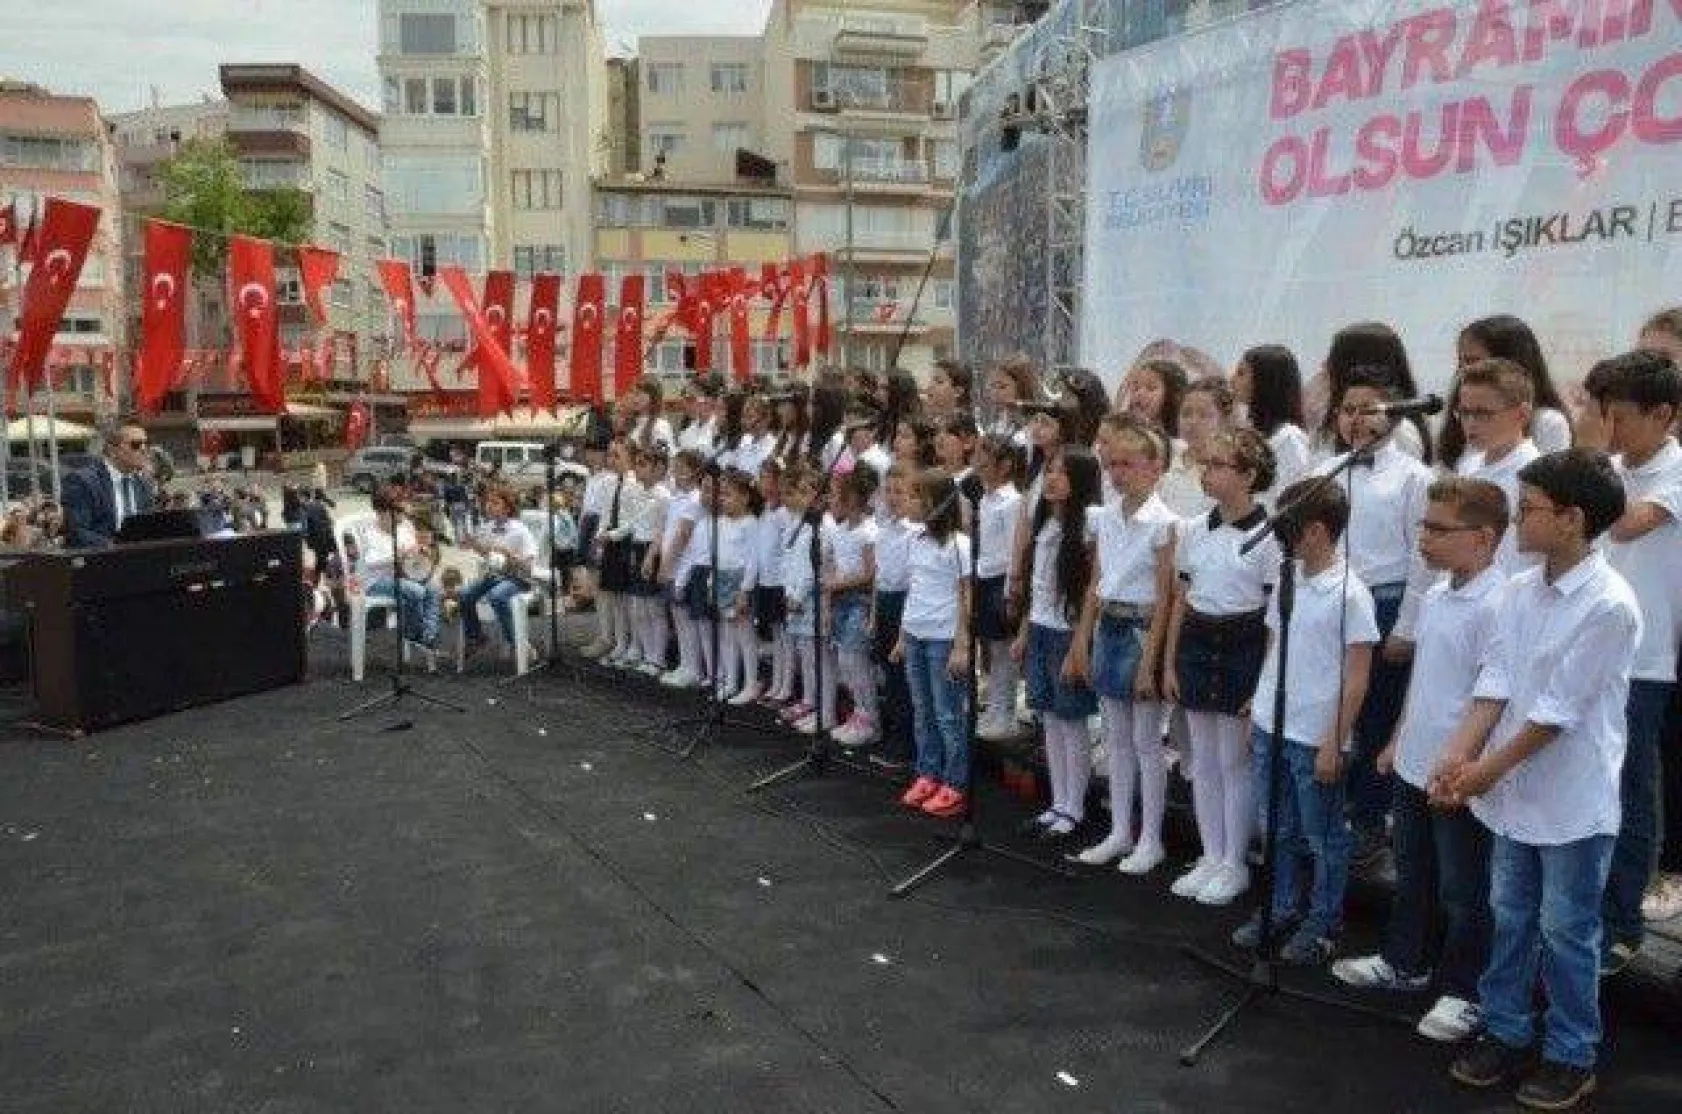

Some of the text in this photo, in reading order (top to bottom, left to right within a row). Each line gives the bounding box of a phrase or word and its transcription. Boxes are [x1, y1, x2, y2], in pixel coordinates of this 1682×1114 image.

[1260, 84, 1534, 206] OLSUN
[1394, 224, 1484, 260] Özcan
[1492, 206, 1637, 258] IŞIKLAR
